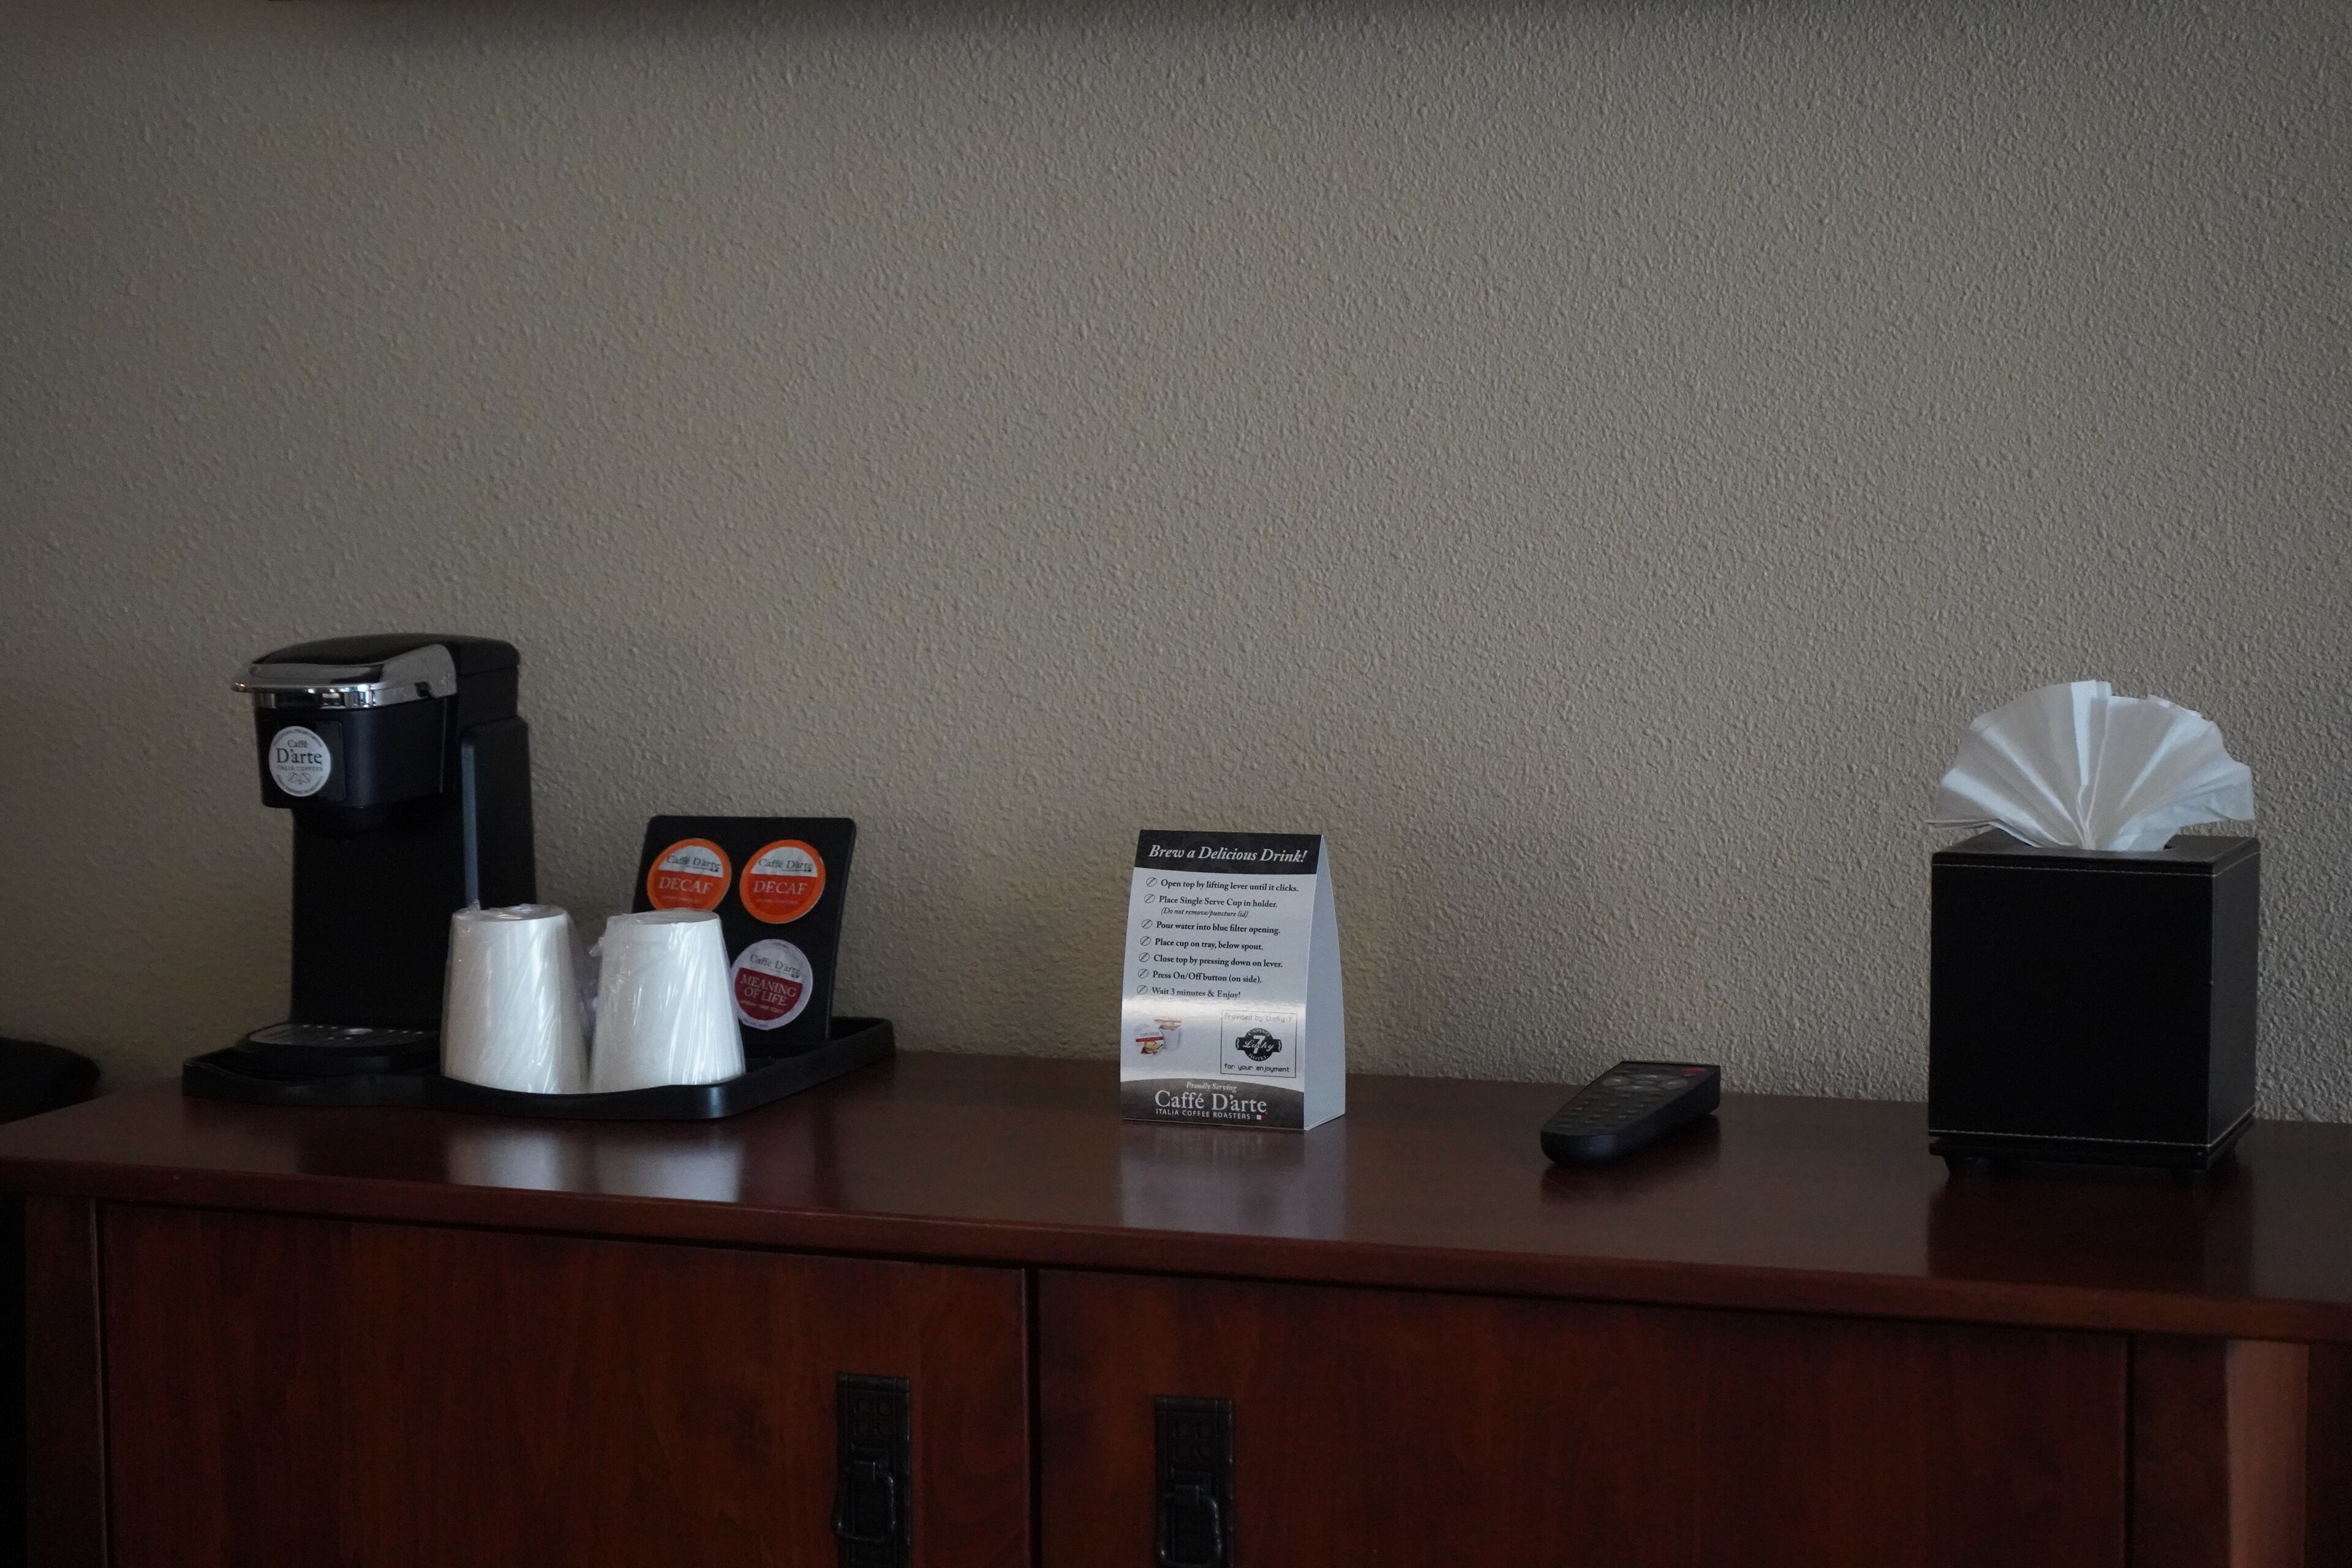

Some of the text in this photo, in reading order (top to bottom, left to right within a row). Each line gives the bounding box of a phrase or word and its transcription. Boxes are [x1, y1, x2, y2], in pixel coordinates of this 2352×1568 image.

[1148, 844, 1308, 862] Brew a Delicious Drink!
[658, 876, 714, 894] DECAF
[753, 880, 809, 895] DECAF
[1161, 878, 1182, 889] Open
[1196, 879, 1205, 889] by
[1206, 880, 1229, 891] lifting
[1276, 883, 1299, 892] clicks.
[1159, 895, 1178, 904] Place
[1180, 897, 1203, 907] Single
[1226, 898, 1242, 908] Cup
[1161, 907, 1173, 915] (Do
[1185, 910, 1237, 918] remove/puncture
[1237, 910, 1249, 919] lid)
[1156, 921, 1173, 929] Pour
[1249, 927, 1281, 936] opening.
[1155, 938, 1174, 946] Place
[1201, 941, 1216, 950] tray,
[1176, 957, 1188, 965] top
[1189, 955, 1198, 965] by
[1199, 957, 1229, 968] pressing
[1263, 959, 1283, 968] lever.
[1152, 970, 1262, 984] Press On/Off button (on side).
[740, 974, 797, 997] MEANING
[744, 987, 787, 1006] OF LIFE
[1217, 990, 1241, 1000] Enjoy!
[1242, 1039, 1275, 1052] Lucky
[1253, 1035, 1266, 1054] 7
[1186, 1081, 1237, 1093] Proudly Serving
[1155, 1090, 1267, 1113] Caffé D'arte
